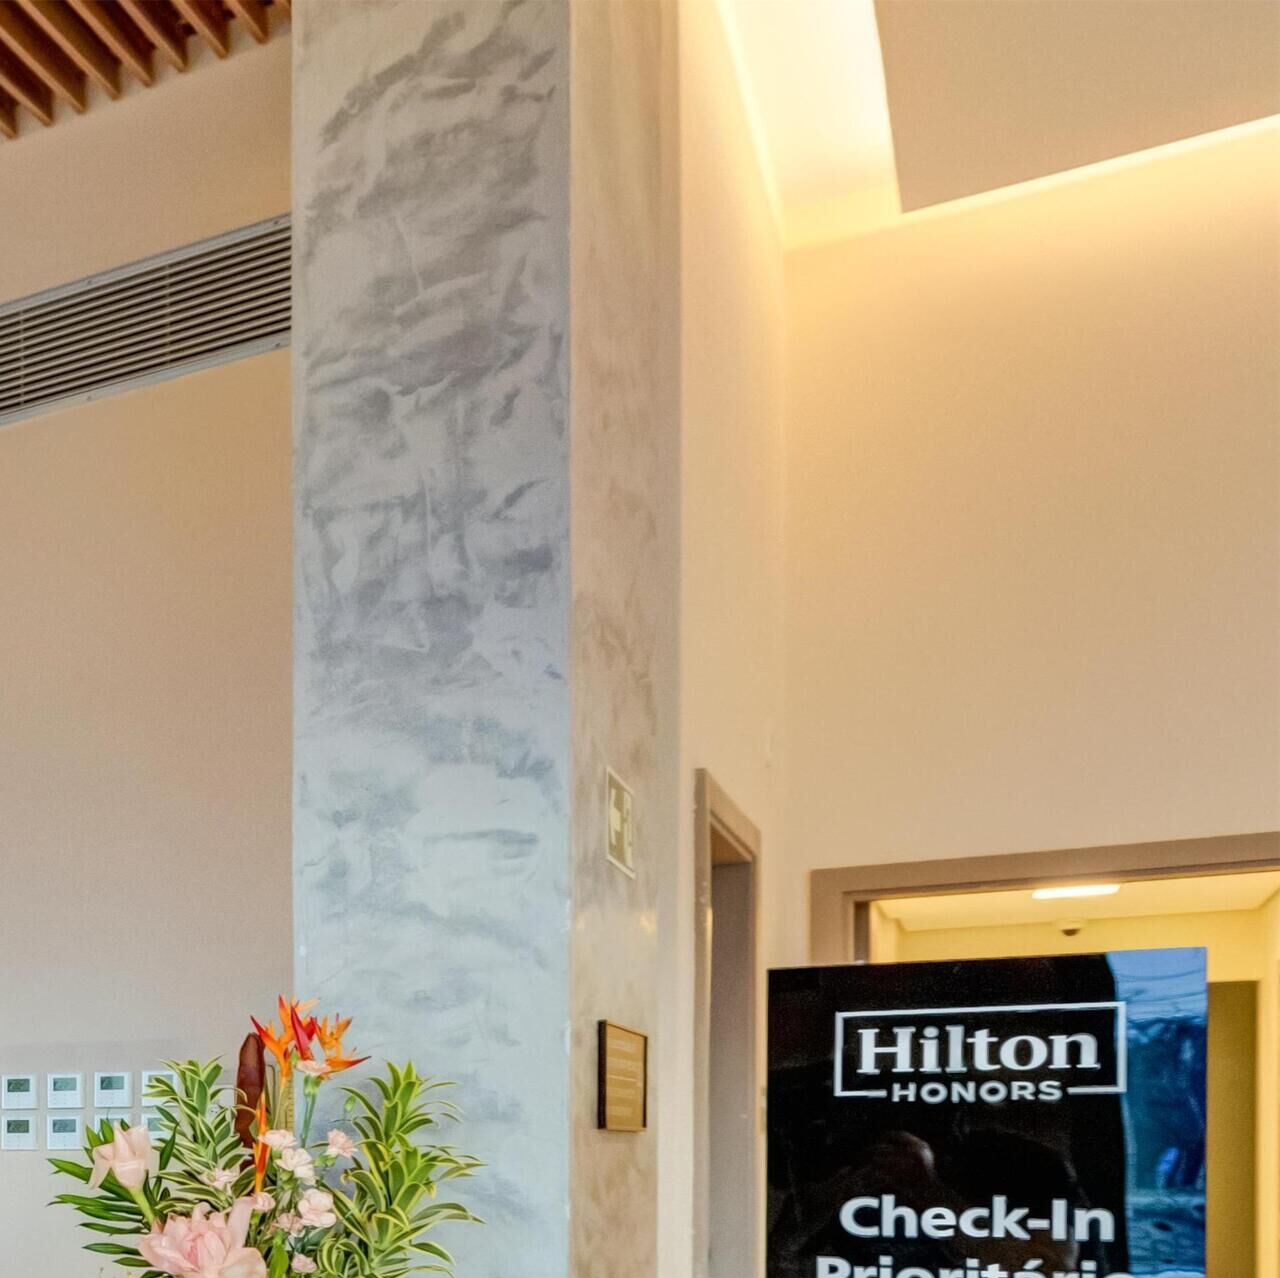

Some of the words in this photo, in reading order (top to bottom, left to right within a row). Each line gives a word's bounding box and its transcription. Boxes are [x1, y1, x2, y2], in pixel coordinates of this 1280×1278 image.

[857, 1025, 1101, 1074] Hilton
[891, 1081, 1063, 1102] HONORS
[839, 1195, 1115, 1242] Check-In
